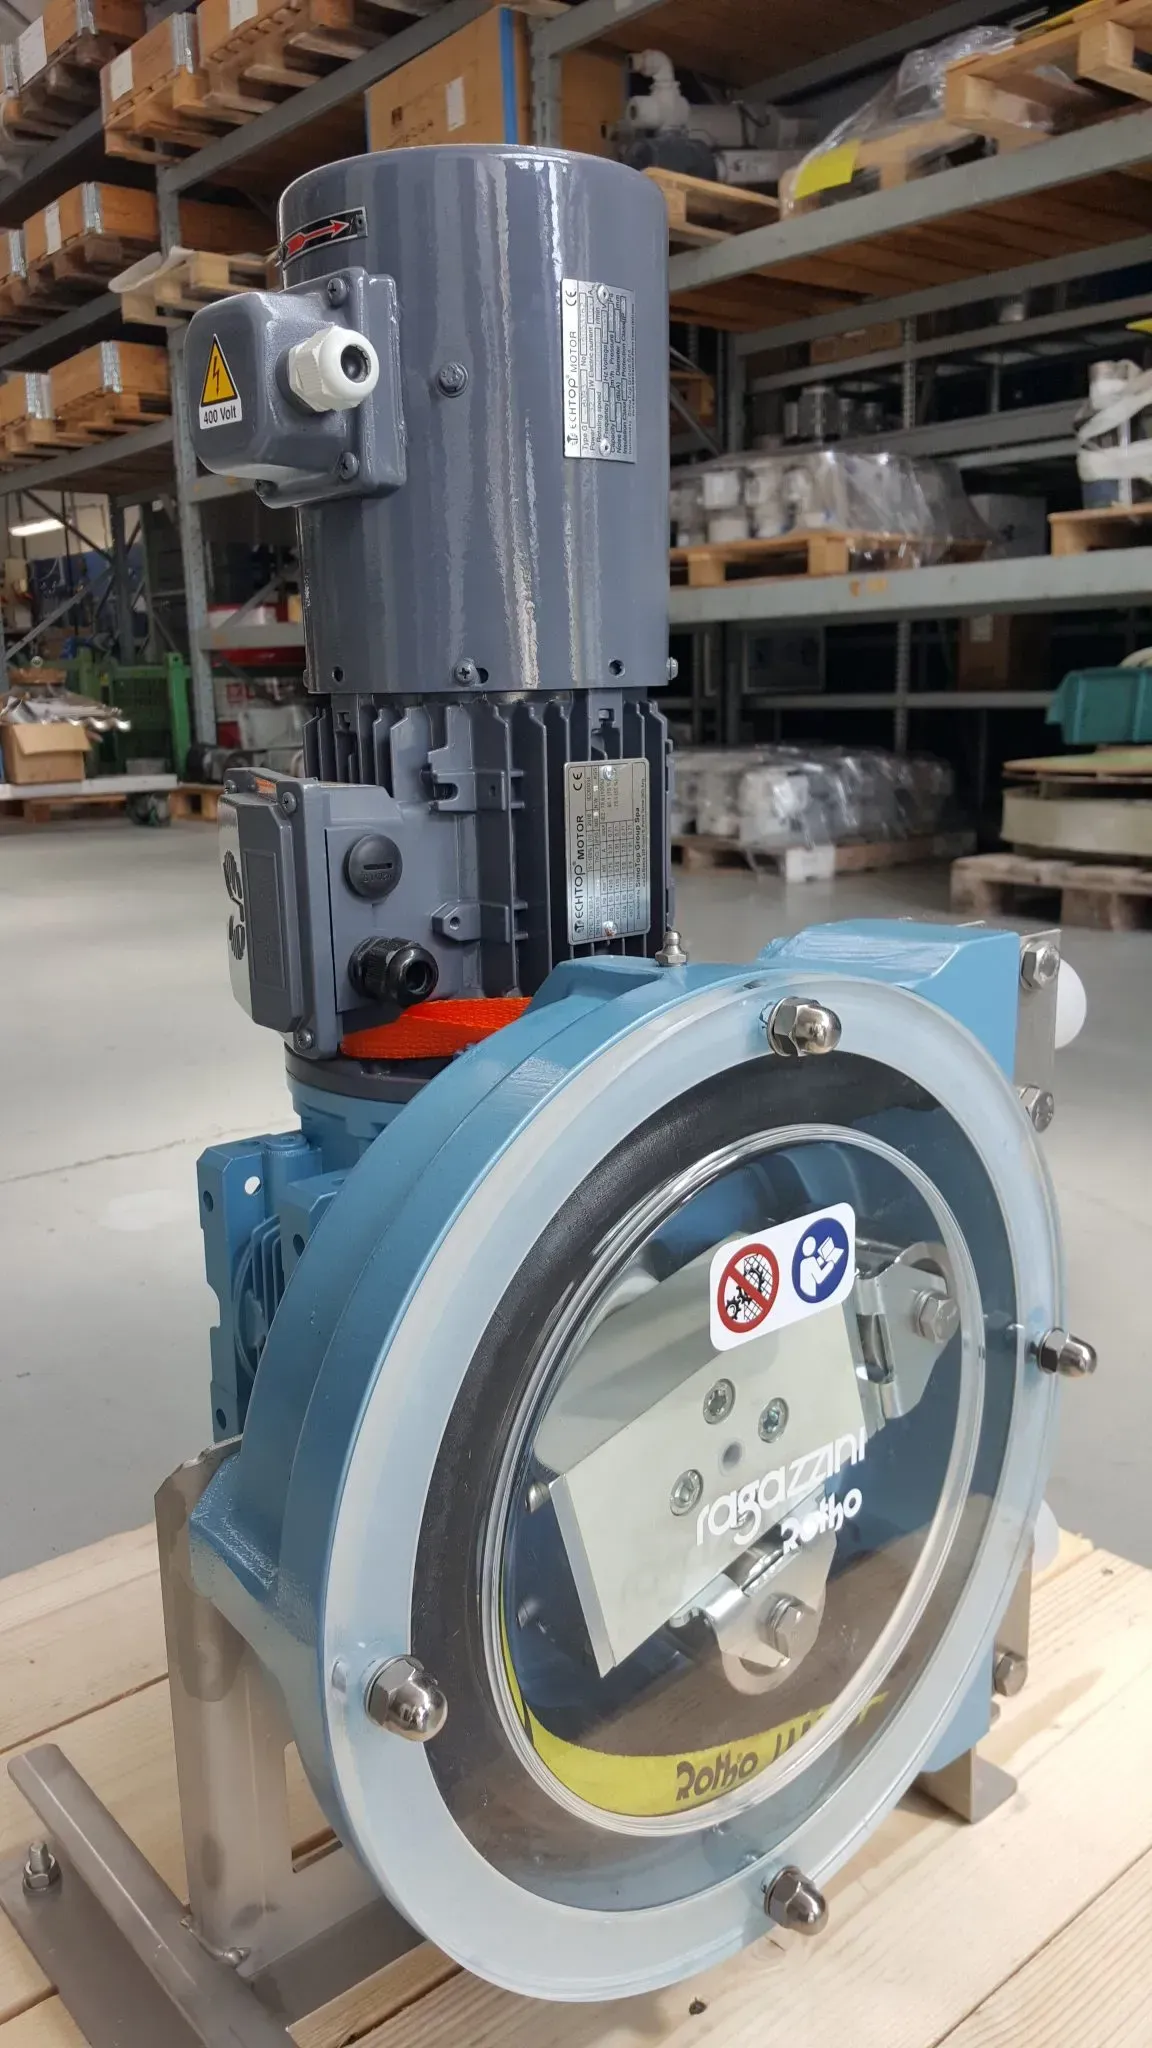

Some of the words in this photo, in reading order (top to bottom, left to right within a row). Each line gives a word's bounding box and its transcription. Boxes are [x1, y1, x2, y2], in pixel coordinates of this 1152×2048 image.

[566, 290, 576, 306] CE
[203, 409, 218, 424] 400
[220, 406, 237, 421] Volt
[573, 772, 582, 791] CE
[696, 1427, 867, 1547] ragazzini
[780, 1487, 863, 1556] Rotho
[675, 1750, 759, 1801] Rotho
